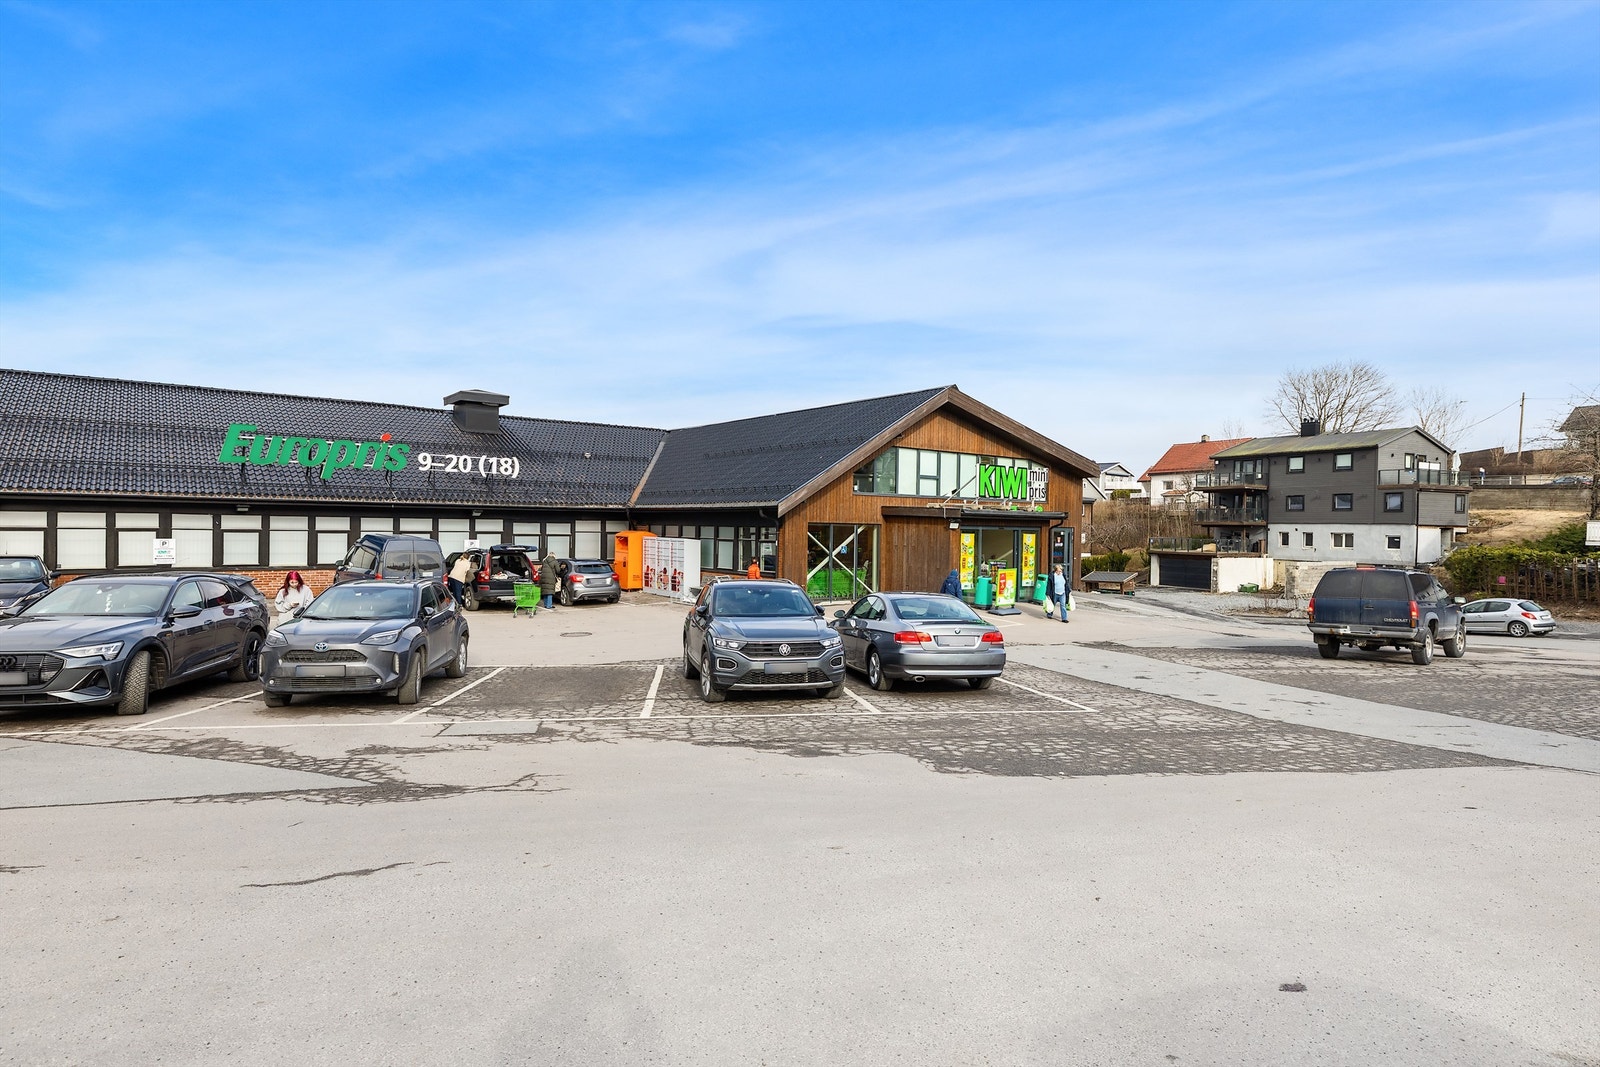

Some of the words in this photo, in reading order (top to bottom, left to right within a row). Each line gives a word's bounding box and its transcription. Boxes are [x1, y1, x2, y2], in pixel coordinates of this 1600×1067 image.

[218, 423, 410, 479] Europris
[479, 455, 520, 478] (18)
[1029, 468, 1049, 482] mini
[979, 464, 1028, 499] KIWI
[1029, 484, 1047, 500] pris
